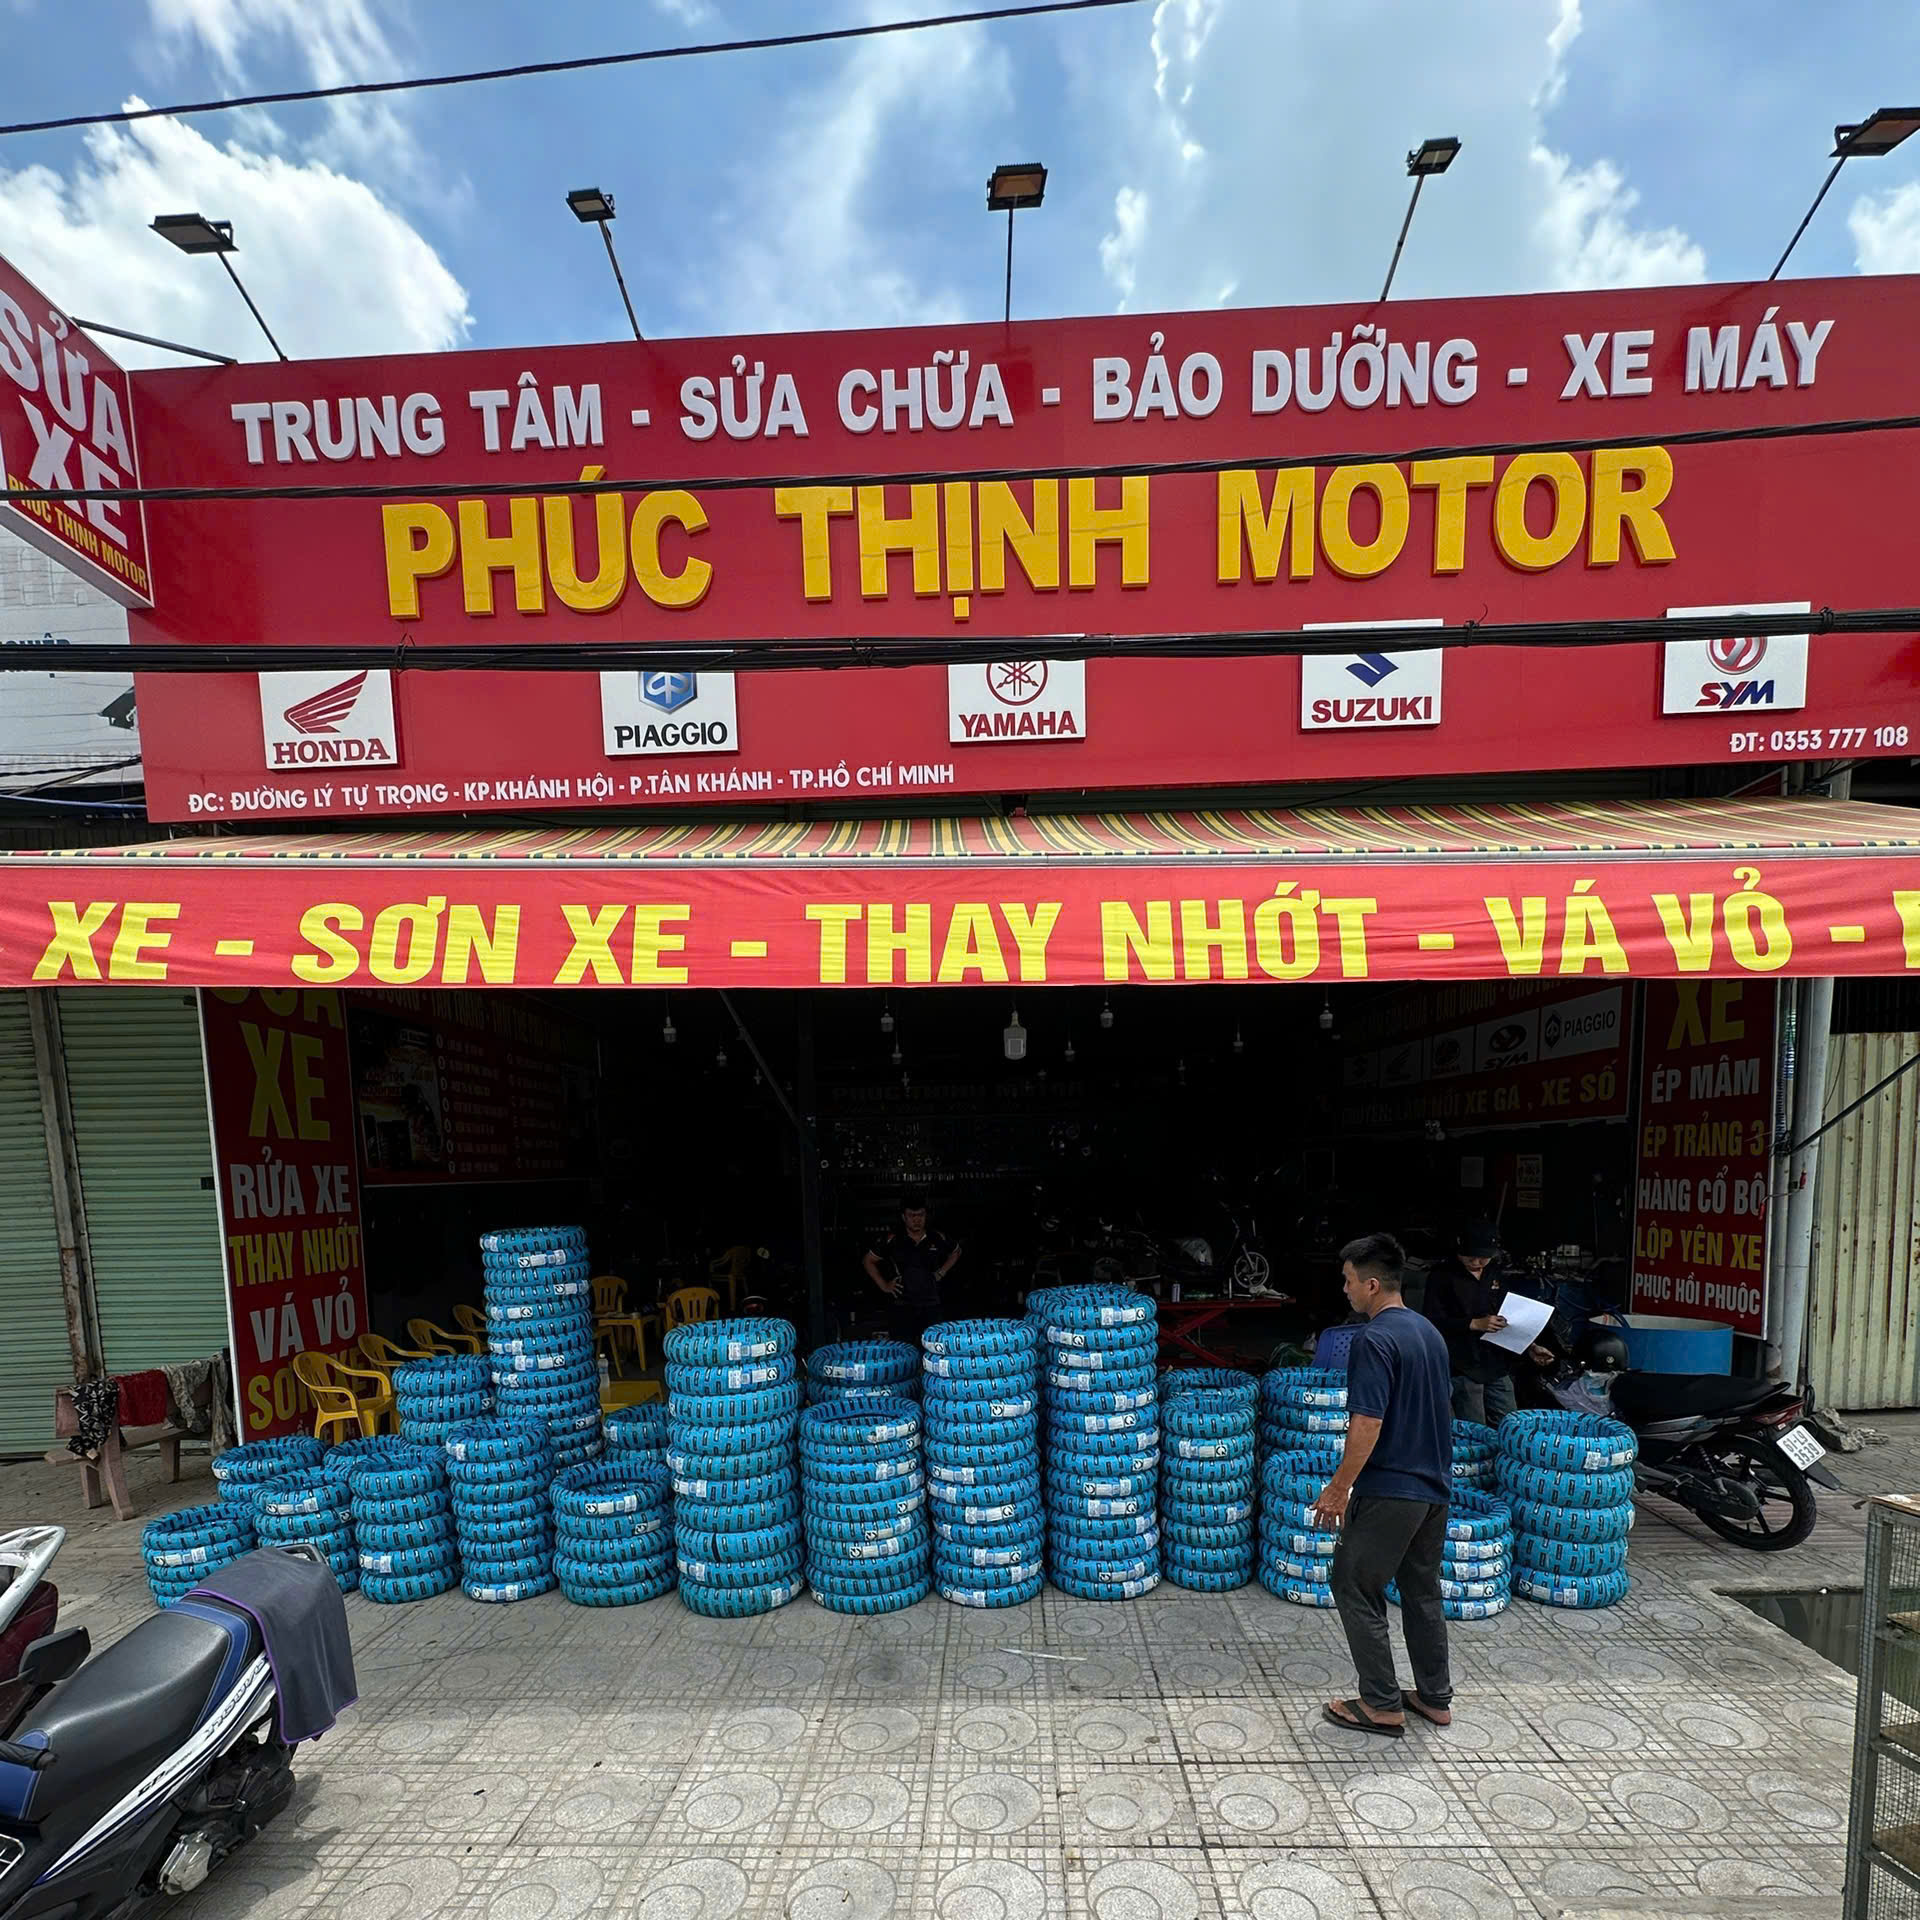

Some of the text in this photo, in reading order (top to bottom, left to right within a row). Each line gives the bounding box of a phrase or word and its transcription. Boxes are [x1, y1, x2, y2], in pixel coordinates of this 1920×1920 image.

[230, 392, 446, 465] TRUNG
[468, 372, 604, 453] TÂM
[679, 354, 809, 441] SỬA
[837, 350, 1014, 434] CHỮA
[1091, 331, 1224, 423] BẢO
[1251, 323, 1478, 416] DƯỠNG
[1559, 329, 1654, 401] XE
[1684, 305, 1834, 395] MÁY
[19, 395, 128, 550] XE
[381, 445, 1677, 622] PHÚC THỊNH MOTOR
[101, 539, 148, 592] MOTOR
[1311, 694, 1432, 723] SUZUKI
[1697, 678, 1775, 708] SYM
[616, 721, 728, 750] PIAGGIO
[960, 708, 1076, 738] YAMAHA
[1730, 725, 1909, 753] ĐT: 0353 777 108
[272, 736, 390, 767] HONDA
[187, 792, 225, 813] ĐC:
[229, 783, 308, 812] ĐƯỜNG
[313, 781, 335, 809] LÝ
[341, 783, 369, 813] TỰ
[374, 782, 449, 812] TRỌNG
[464, 774, 570, 802] KP.KHÁNH
[577, 770, 614, 800] HỘI
[629, 767, 691, 796] P.TÂN
[696, 765, 773, 794] KHÁNH
[789, 759, 851, 790] TP.HỒ
[857, 760, 892, 787] CHÍ
[898, 763, 954, 786] MINH
[32, 901, 183, 981] XE
[290, 895, 521, 985] SƠN
[552, 904, 690, 985] XE
[805, 903, 1063, 984] THAY
[1100, 880, 1378, 982] NHỚT
[1484, 877, 1630, 975] VÁ
[1650, 865, 1794, 973] VỎ
[1564, 1009, 1617, 1039] PIAGGIO
[1665, 981, 1746, 1050] XE
[238, 1017, 332, 1142] XE
[1541, 1077, 1571, 1107] XE
[1579, 1058, 1618, 1105] SỐ
[1651, 1053, 1760, 1105] ÉP MÂM
[1642, 1110, 1766, 1159] ÉP TRẢNG 3
[228, 1143, 352, 1220] RỬA XE
[1638, 1170, 1692, 1212] HÀNG
[1697, 1164, 1729, 1215] CỔ
[228, 1214, 361, 1289] THAY NHỚT
[1635, 1219, 1763, 1272] LỘP YÊN XE
[249, 1275, 357, 1364] VÁ VỎ
[1634, 1271, 1761, 1319] PHỤC HỒI PHUỘC
